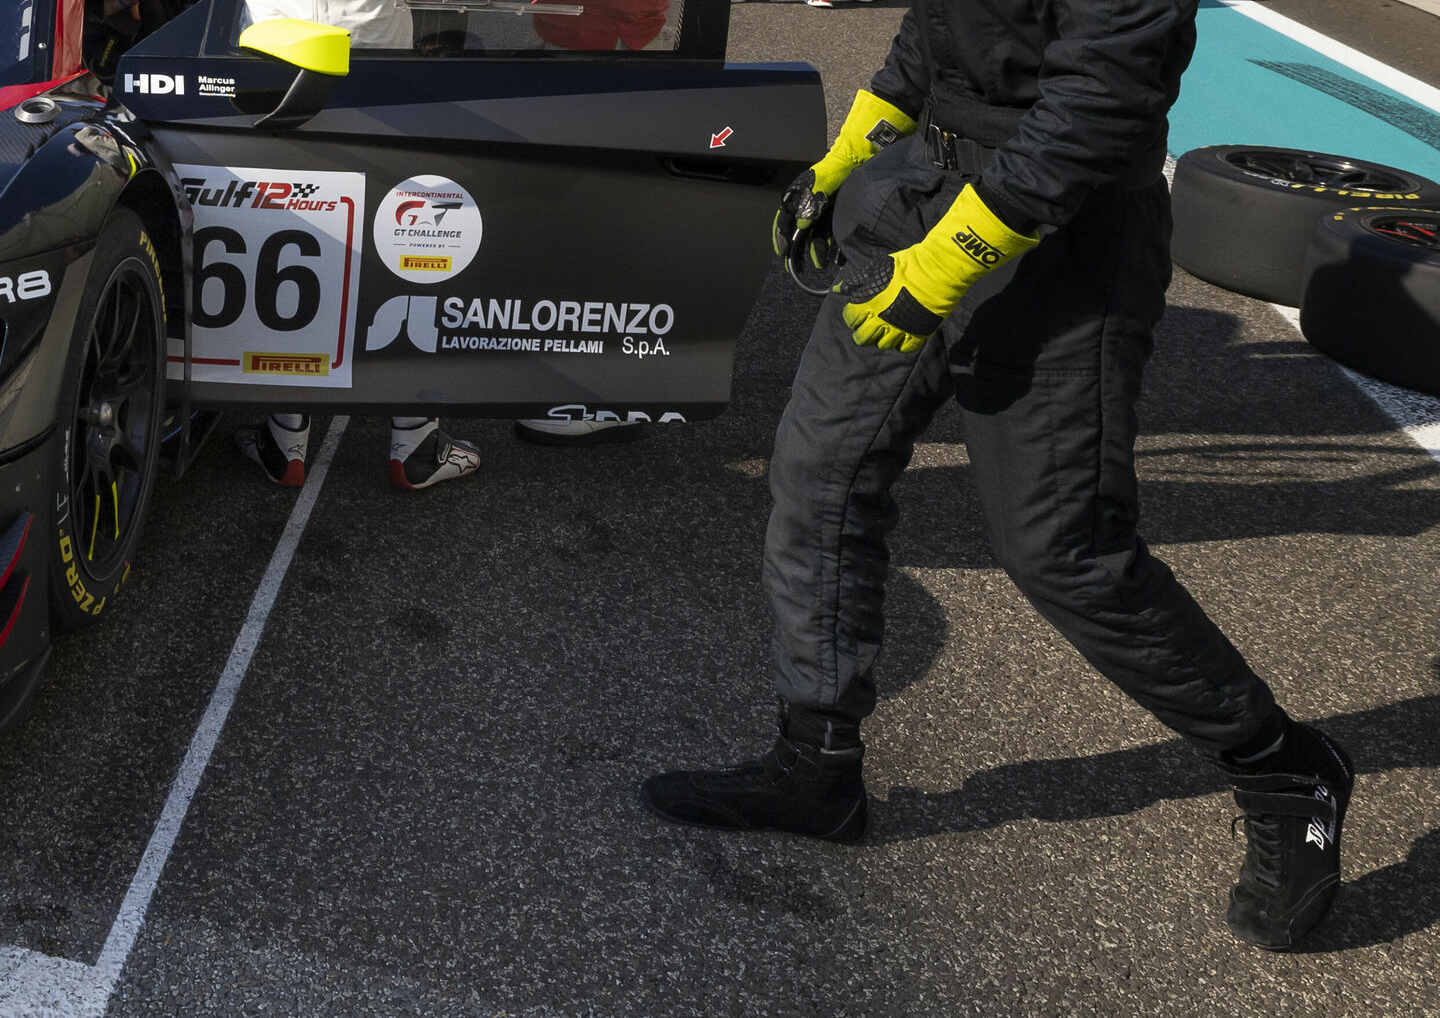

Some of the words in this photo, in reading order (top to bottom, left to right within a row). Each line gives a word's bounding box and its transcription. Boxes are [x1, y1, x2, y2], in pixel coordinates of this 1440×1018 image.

[124, 74, 185, 95] HDI
[198, 76, 236, 85] Marcus
[396, 191, 464, 199] INTERCONTINENTAL
[394, 229, 406, 237] GT
[408, 229, 462, 238] CHALLENGE
[955, 231, 1000, 265] OMP
[404, 257, 448, 269] PIRELLI
[192, 226, 321, 332] 66
[441, 296, 675, 336] SANLORENZO
[442, 336, 541, 351] LAVORAZIONE
[544, 339, 604, 354] PELLAMI
[622, 336, 671, 359] S.p.A.
[251, 355, 322, 373] PIRELLI
